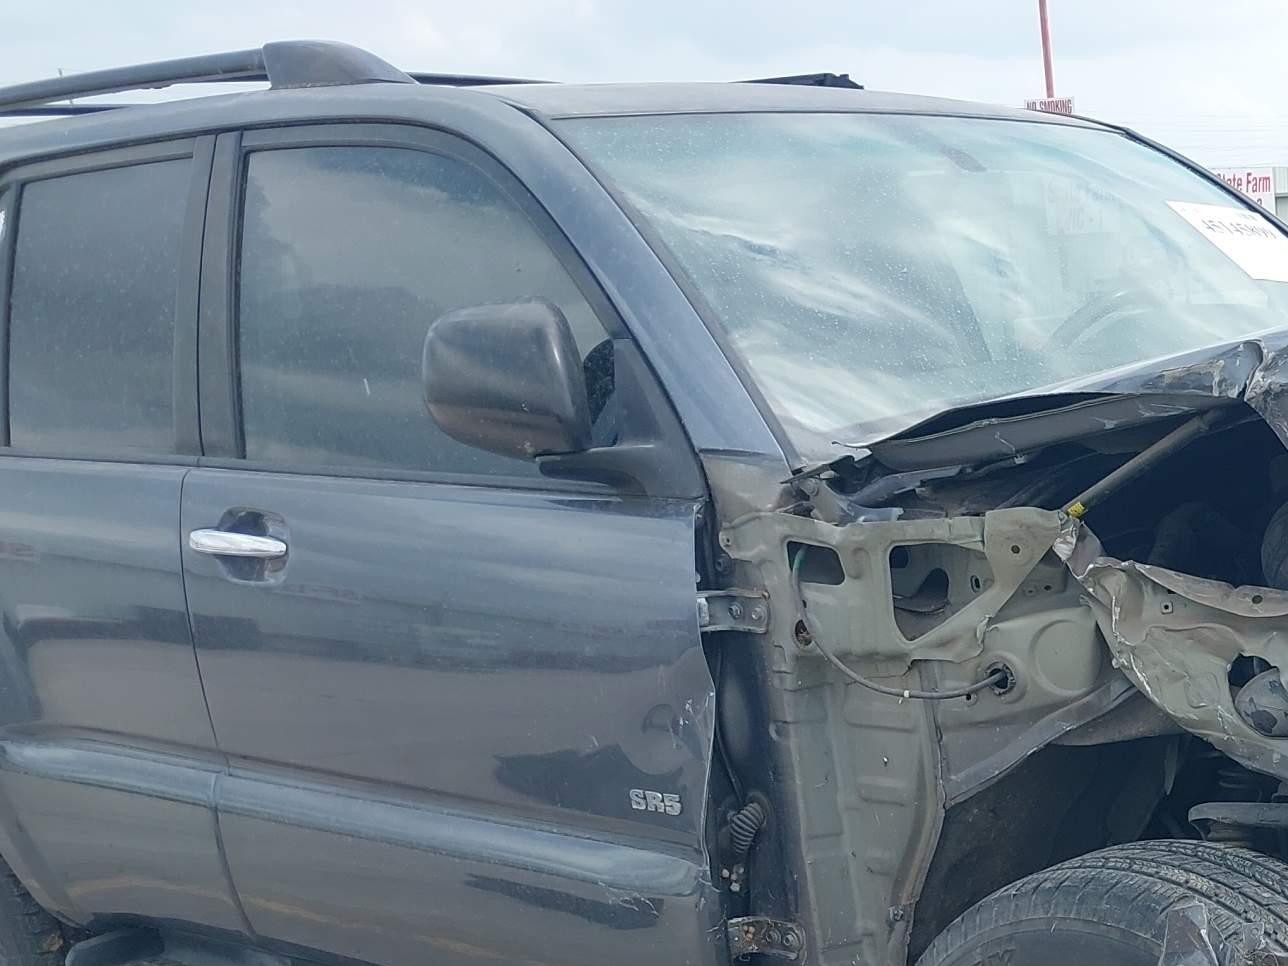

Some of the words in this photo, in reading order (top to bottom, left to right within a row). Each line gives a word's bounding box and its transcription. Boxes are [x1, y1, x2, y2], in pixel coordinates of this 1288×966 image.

[1026, 101, 1037, 111] NO
[1040, 99, 1072, 114] SMOKING
[1246, 172, 1271, 193] Farm
[629, 788, 682, 816] SR5
